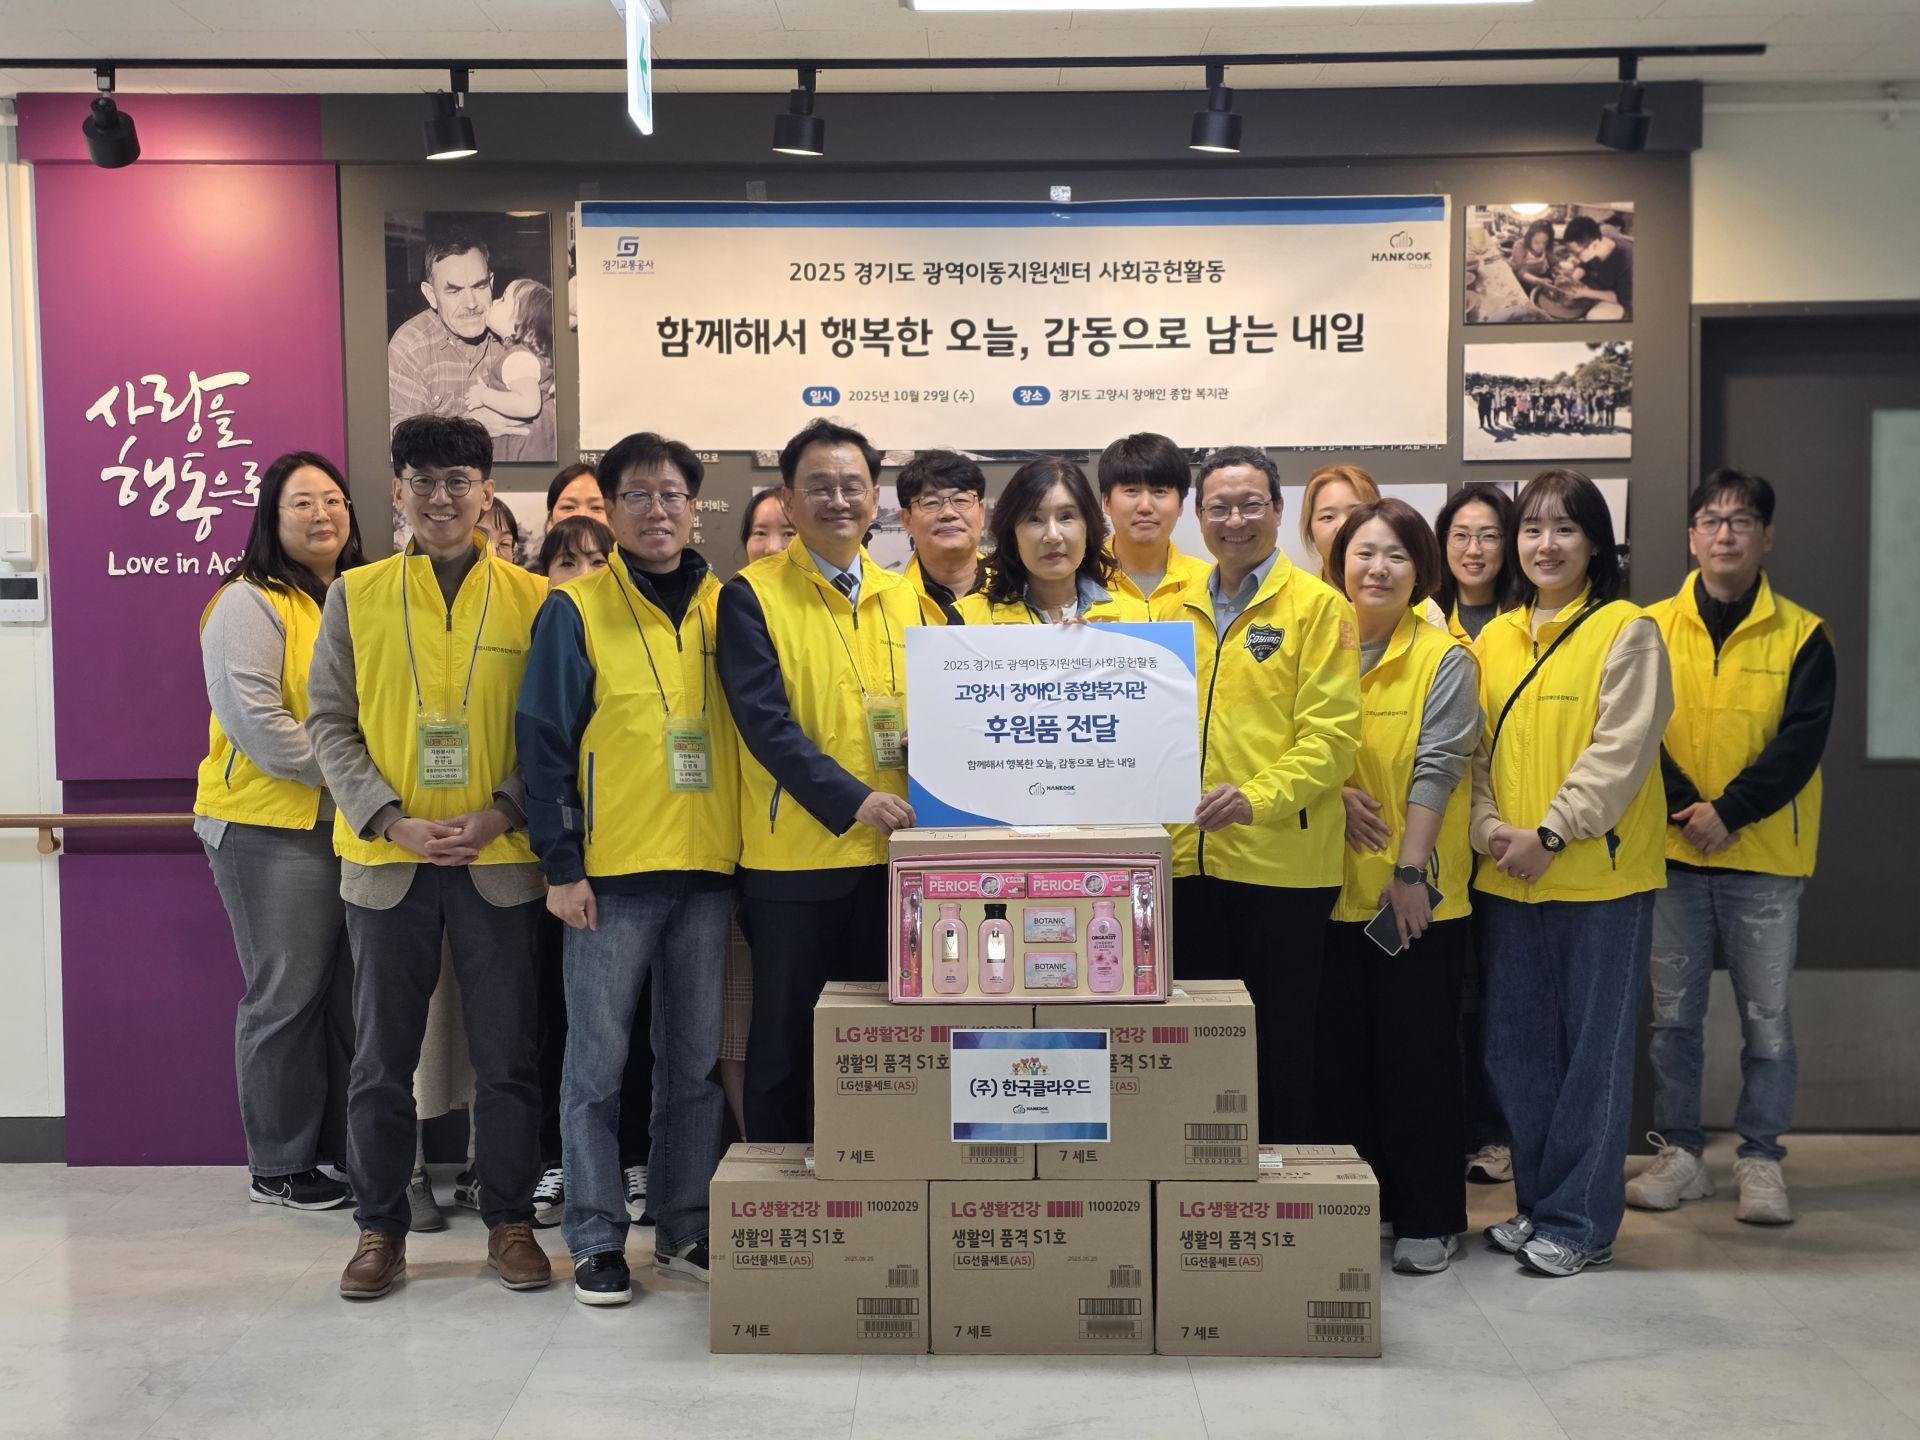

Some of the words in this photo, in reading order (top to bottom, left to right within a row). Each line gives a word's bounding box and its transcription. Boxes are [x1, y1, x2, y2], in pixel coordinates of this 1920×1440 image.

[1371, 252, 1432, 262] HANKOOK
[602, 260, 654, 271] 경기교통공사
[789, 262, 846, 282] 2025
[854, 262, 916, 286] 경기도
[922, 261, 1091, 286] 광역이동지원센터
[1099, 259, 1227, 285] 사회공헌활동
[656, 316, 806, 358] 함께해서
[820, 316, 934, 359] 행복한
[946, 317, 1029, 361] 오늘,
[1044, 316, 1191, 358] 감동으로
[1206, 315, 1278, 355] 남는
[1293, 313, 1364, 353] 내일
[809, 389, 832, 403] 일시
[849, 390, 889, 403] 2025년
[893, 390, 919, 403] 10월
[923, 390, 949, 403] 29일
[953, 389, 975, 403] (수)
[1019, 389, 1043, 401] 장소
[1058, 389, 1092, 402] 경기도
[1095, 389, 1129, 401] 고양시
[1132, 388, 1166, 401] 장애인
[1169, 388, 1192, 401] 종합
[1195, 387, 1229, 401] 복지관
[85, 370, 252, 449] 사랑을
[108, 551, 170, 577] Love
[175, 552, 200, 575] in
[943, 660, 970, 671] 2025
[973, 659, 1005, 671] 경기도
[1007, 658, 1093, 671] 광역이동지원센터
[1095, 656, 1159, 670] 사회공헌활동
[954, 683, 1005, 703] 고양시
[984, 714, 1062, 744] 후원품
[1066, 714, 1120, 744] 전달
[967, 760, 1004, 771] 함께해서
[1006, 759, 1034, 770] 행복한
[1035, 759, 1057, 770] 오늘,
[1058, 758, 1095, 770] 감동으로
[1096, 758, 1116, 769] 남는
[1117, 757, 1136, 769] 내일
[929, 880, 978, 892] PERIOE
[1032, 879, 1081, 892] PERIOE
[1033, 917, 1066, 925] BOTANIC
[1194, 1026, 1247, 1037] 11002029
[835, 1054, 878, 1074] 생활의
[883, 1054, 912, 1073] 품격
[916, 1053, 950, 1070] S1호
[1138, 1053, 1173, 1070] S1호
[969, 1078, 998, 1098] (주)
[1001, 1078, 1092, 1098] 한국클라우드
[836, 1150, 845, 1162] 7
[850, 1149, 875, 1165] 세트
[1059, 1150, 1068, 1162] 7
[1072, 1149, 1099, 1165] 세트
[867, 1201, 919, 1212] 11002029
[1088, 1201, 1140, 1212] 11002029
[1318, 1204, 1371, 1215] 11002029
[731, 1228, 773, 1248] 생활의
[779, 1228, 807, 1248] 품격
[812, 1228, 845, 1244] S1호
[952, 1229, 994, 1249] 생활의
[1000, 1229, 1028, 1248] 품격
[1033, 1228, 1067, 1245] S1호
[1179, 1230, 1222, 1250] 생활의
[1228, 1230, 1256, 1250] 품격
[1261, 1231, 1296, 1247] S1호
[732, 1324, 741, 1337] 7
[745, 1323, 771, 1338] 세트
[953, 1325, 963, 1338] 7
[966, 1324, 993, 1339] 세트
[1180, 1326, 1190, 1339] 7
[1193, 1325, 1220, 1340] 세트
